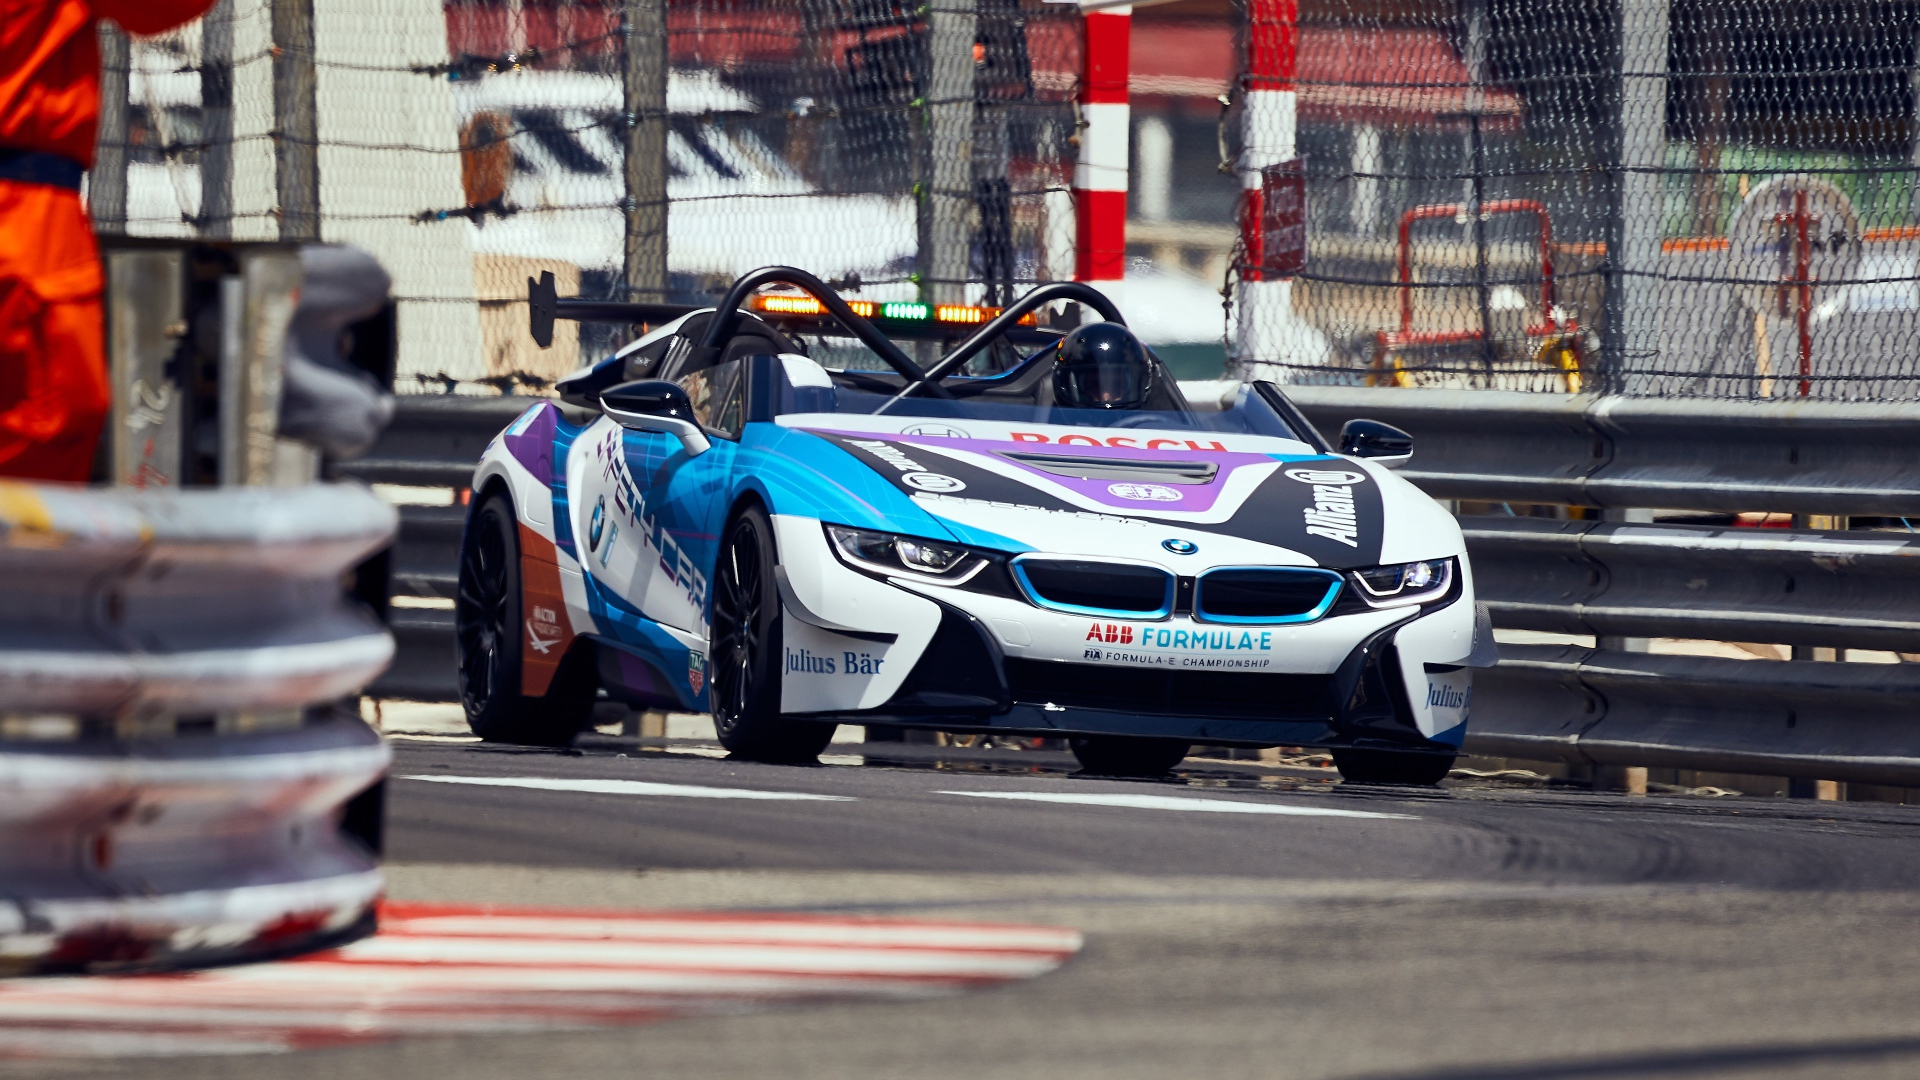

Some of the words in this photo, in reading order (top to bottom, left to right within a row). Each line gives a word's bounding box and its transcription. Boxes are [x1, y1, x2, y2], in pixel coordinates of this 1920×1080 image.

[1009, 432, 1229, 452] BOSCH
[1303, 484, 1358, 548] Allianz
[659, 527, 708, 621] CAR
[1086, 622, 1133, 644] ABB
[690, 653, 703, 670] TAG
[785, 647, 836, 675] Julius
[843, 651, 885, 674] Bär
[1083, 649, 1100, 659] FIA
[1183, 658, 1270, 668] CHAMPIONSHIP
[1424, 683, 1464, 710] Julius
